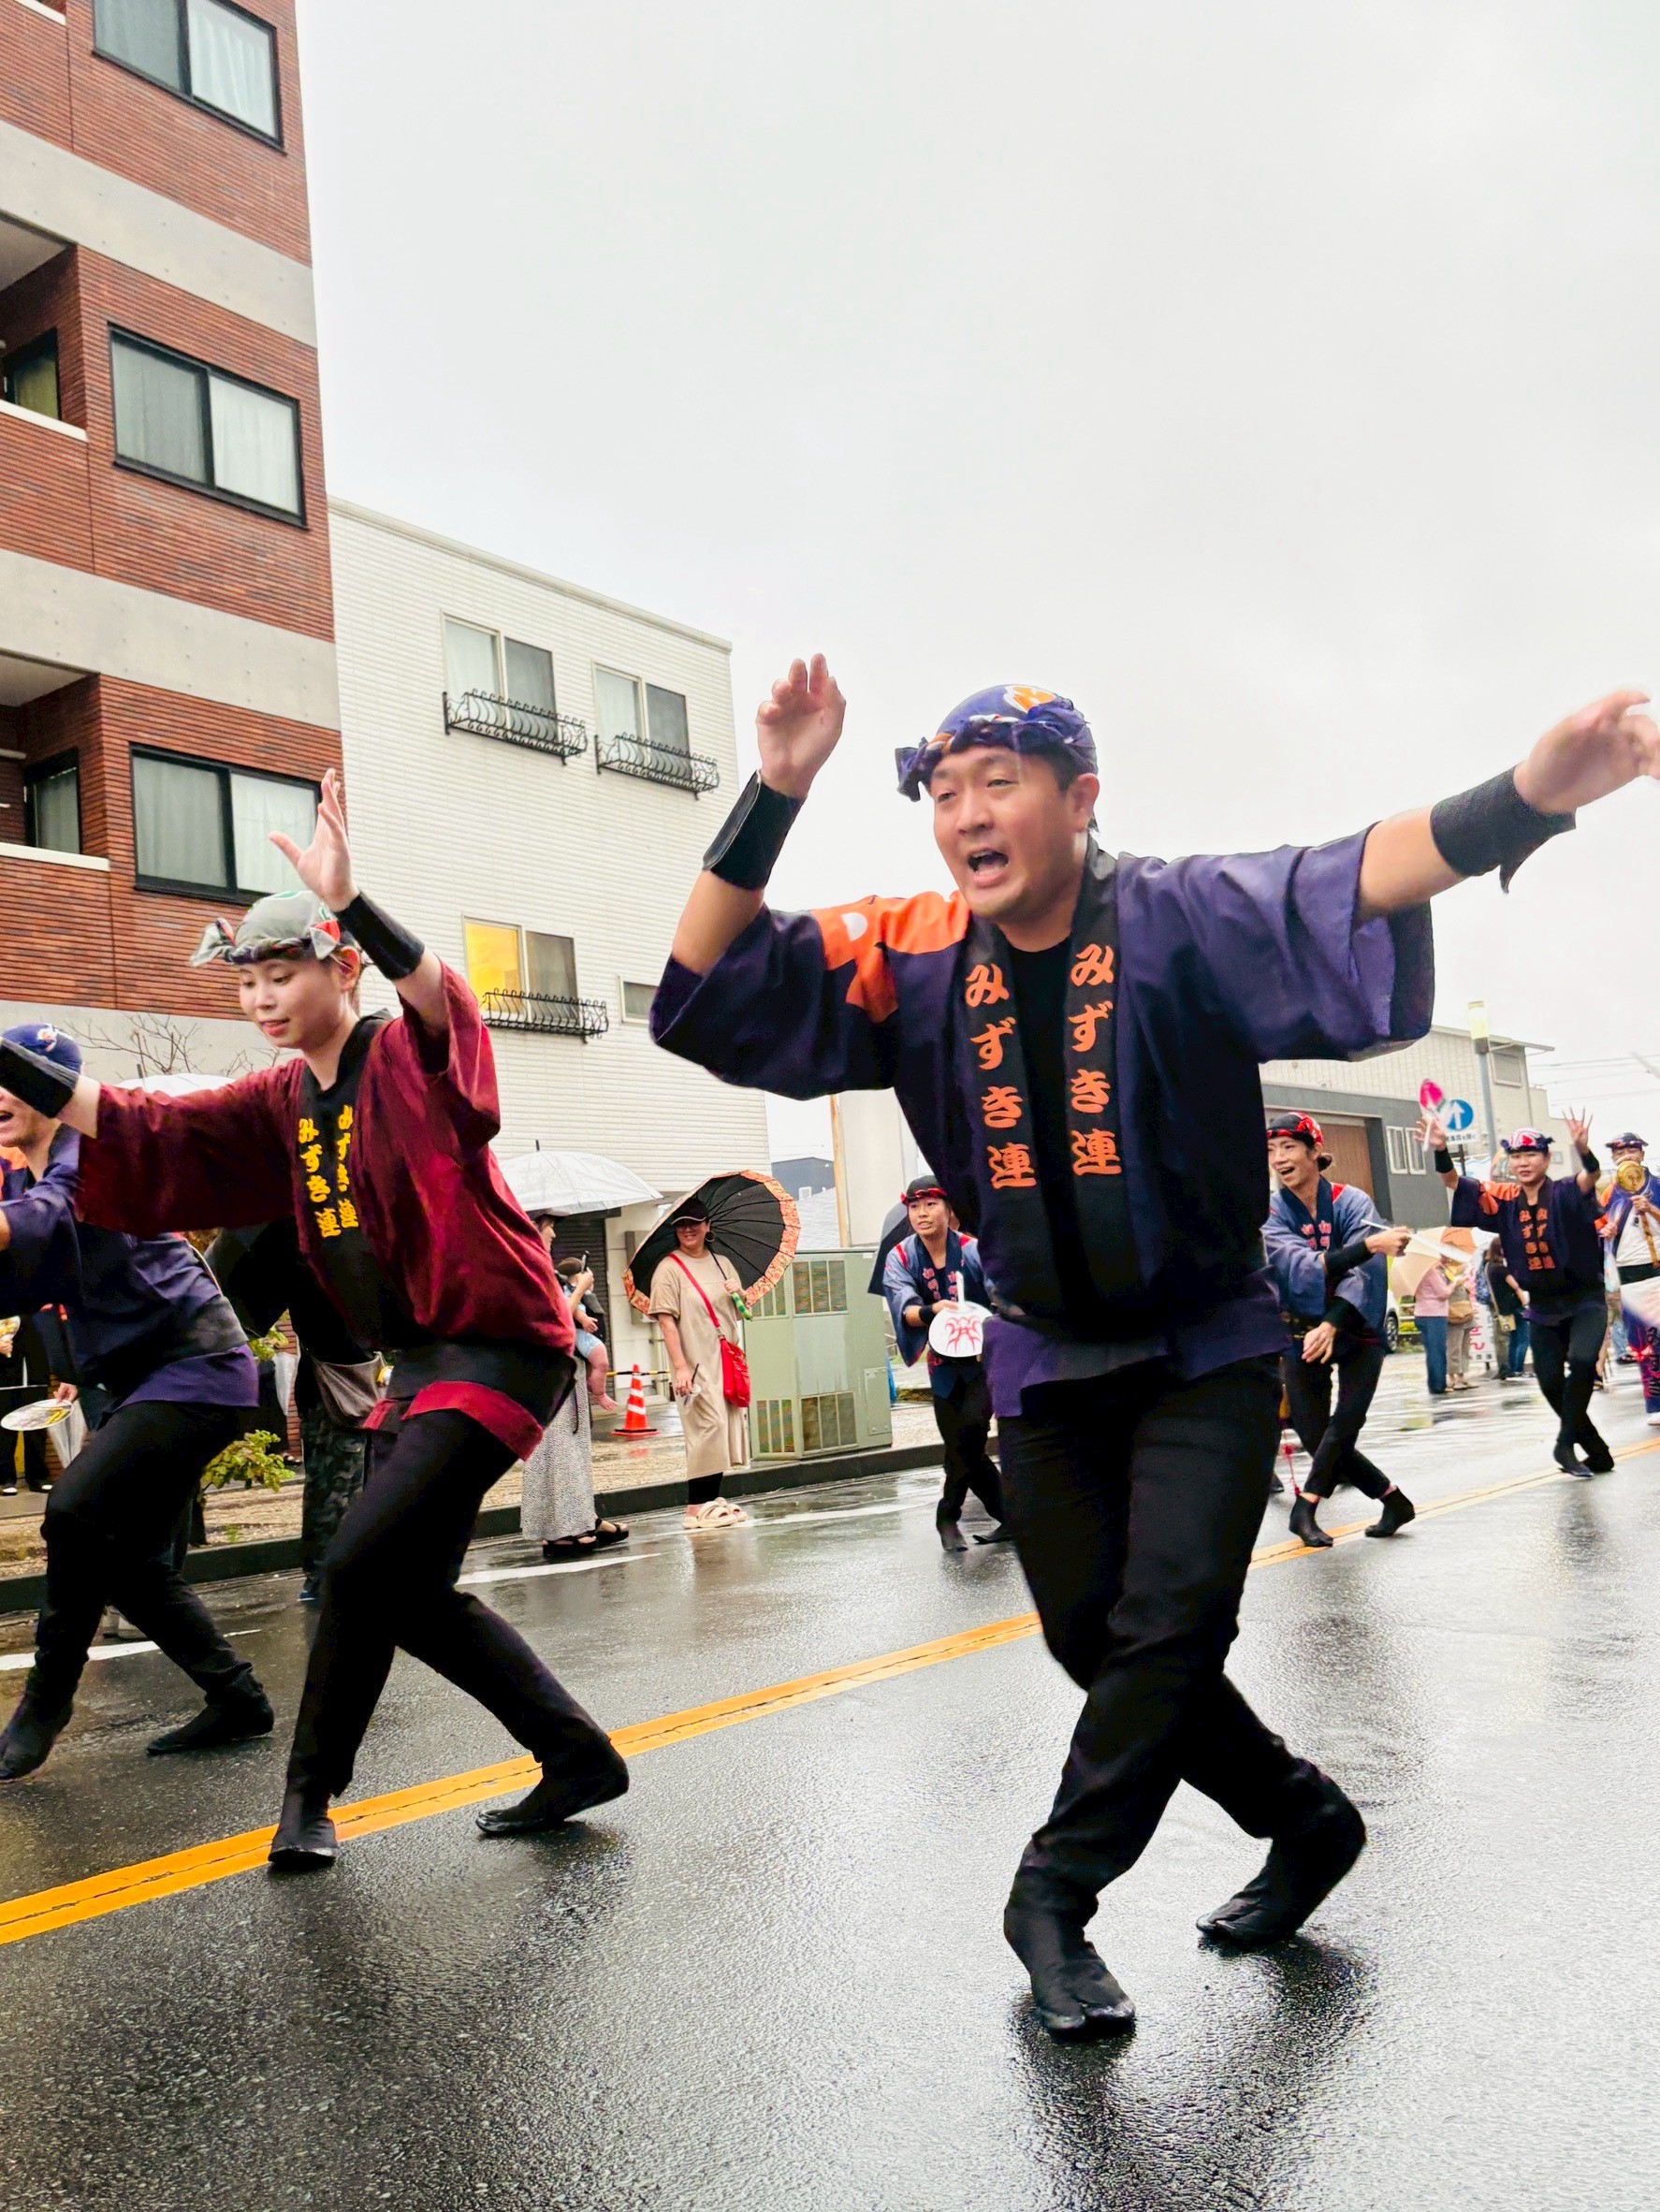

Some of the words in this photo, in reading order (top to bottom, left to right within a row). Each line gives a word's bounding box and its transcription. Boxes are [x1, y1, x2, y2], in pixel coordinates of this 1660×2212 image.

[964, 963, 1038, 1190] みずき連
[1070, 942, 1123, 1176] みずき連
[298, 1117, 342, 1239] みずき連
